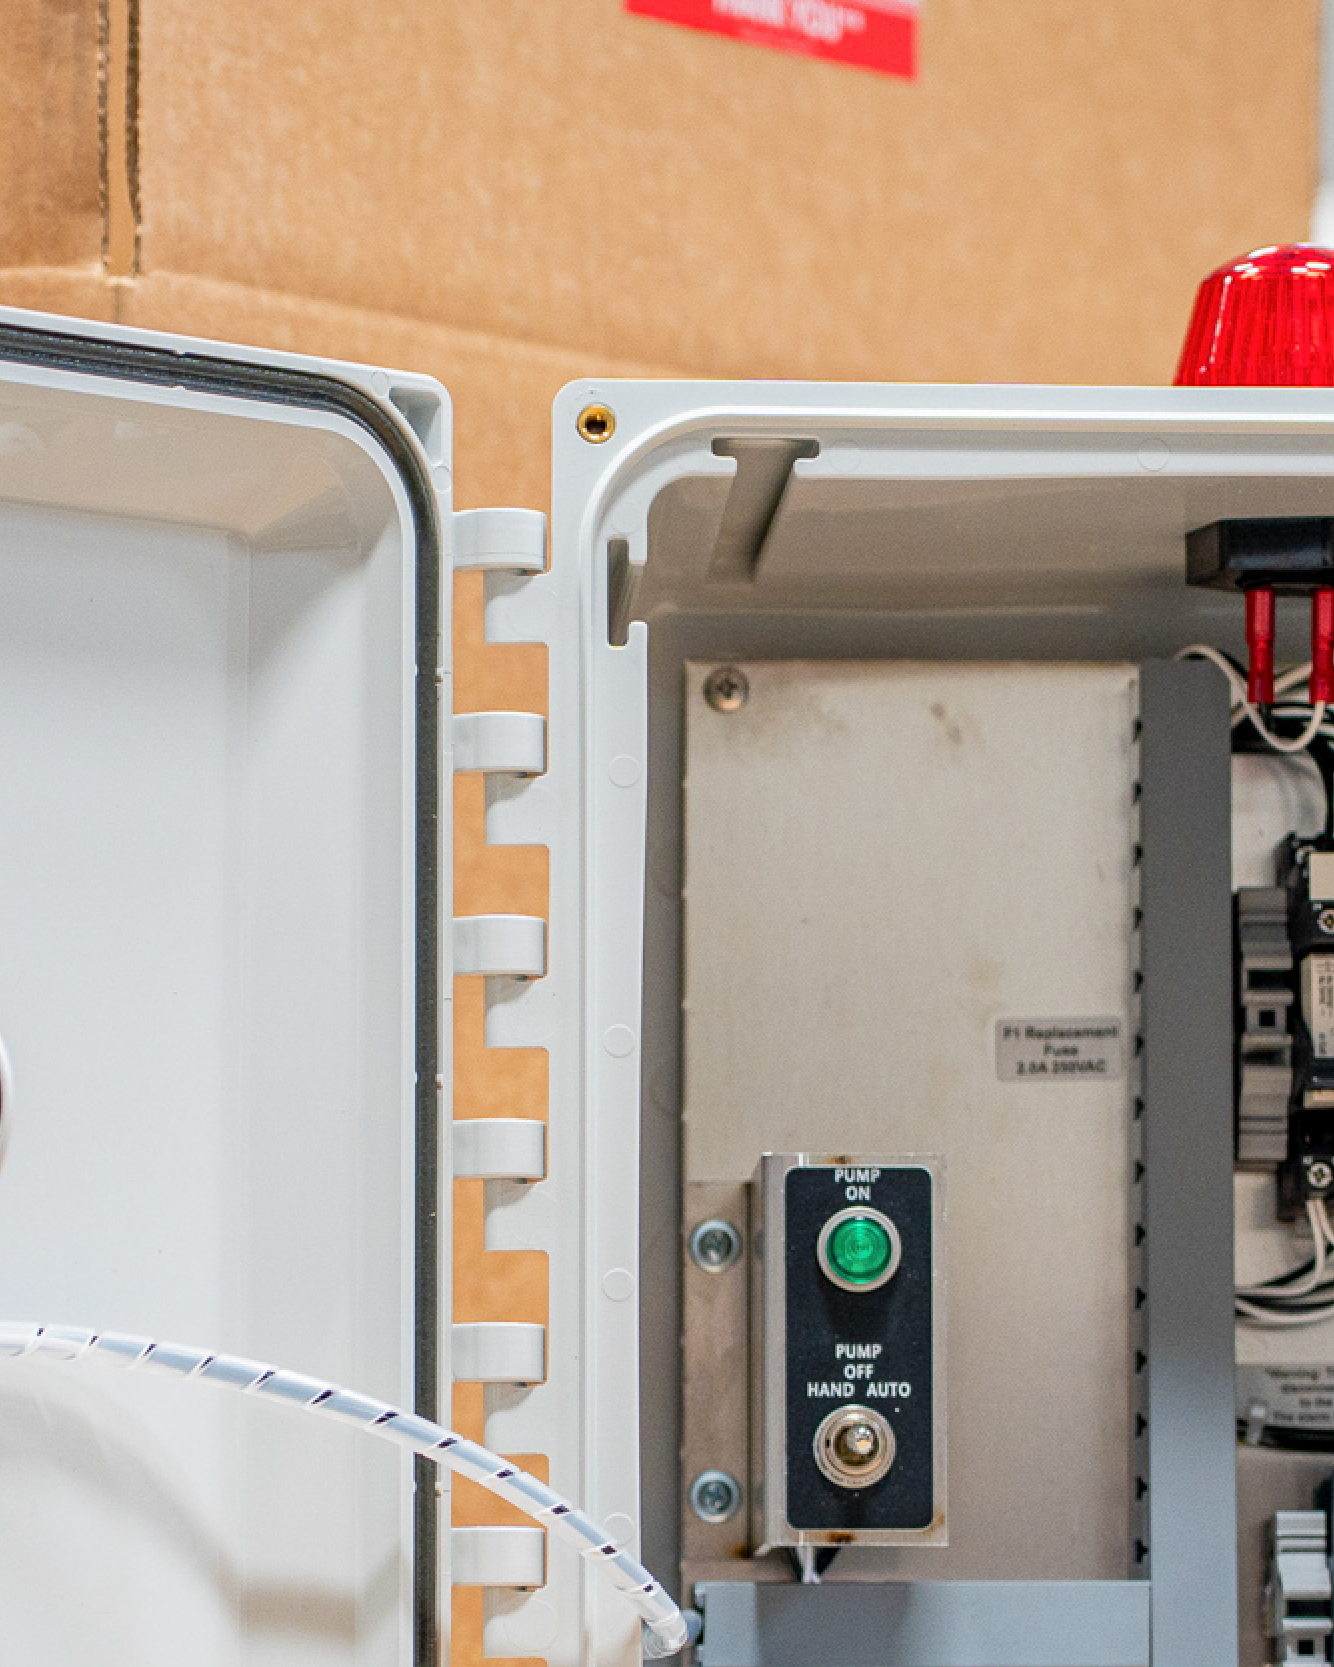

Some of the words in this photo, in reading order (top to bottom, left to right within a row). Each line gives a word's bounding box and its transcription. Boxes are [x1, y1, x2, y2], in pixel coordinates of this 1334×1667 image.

[1024, 1025, 1118, 1041] Replacement
[1043, 1042, 1079, 1056] Fuse
[834, 1168, 881, 1184] PUMP
[845, 1186, 872, 1201] ON
[834, 1343, 883, 1360] PUMP
[843, 1364, 874, 1380] OFF
[806, 1382, 856, 1399] HAND
[866, 1382, 912, 1399] AUTO
